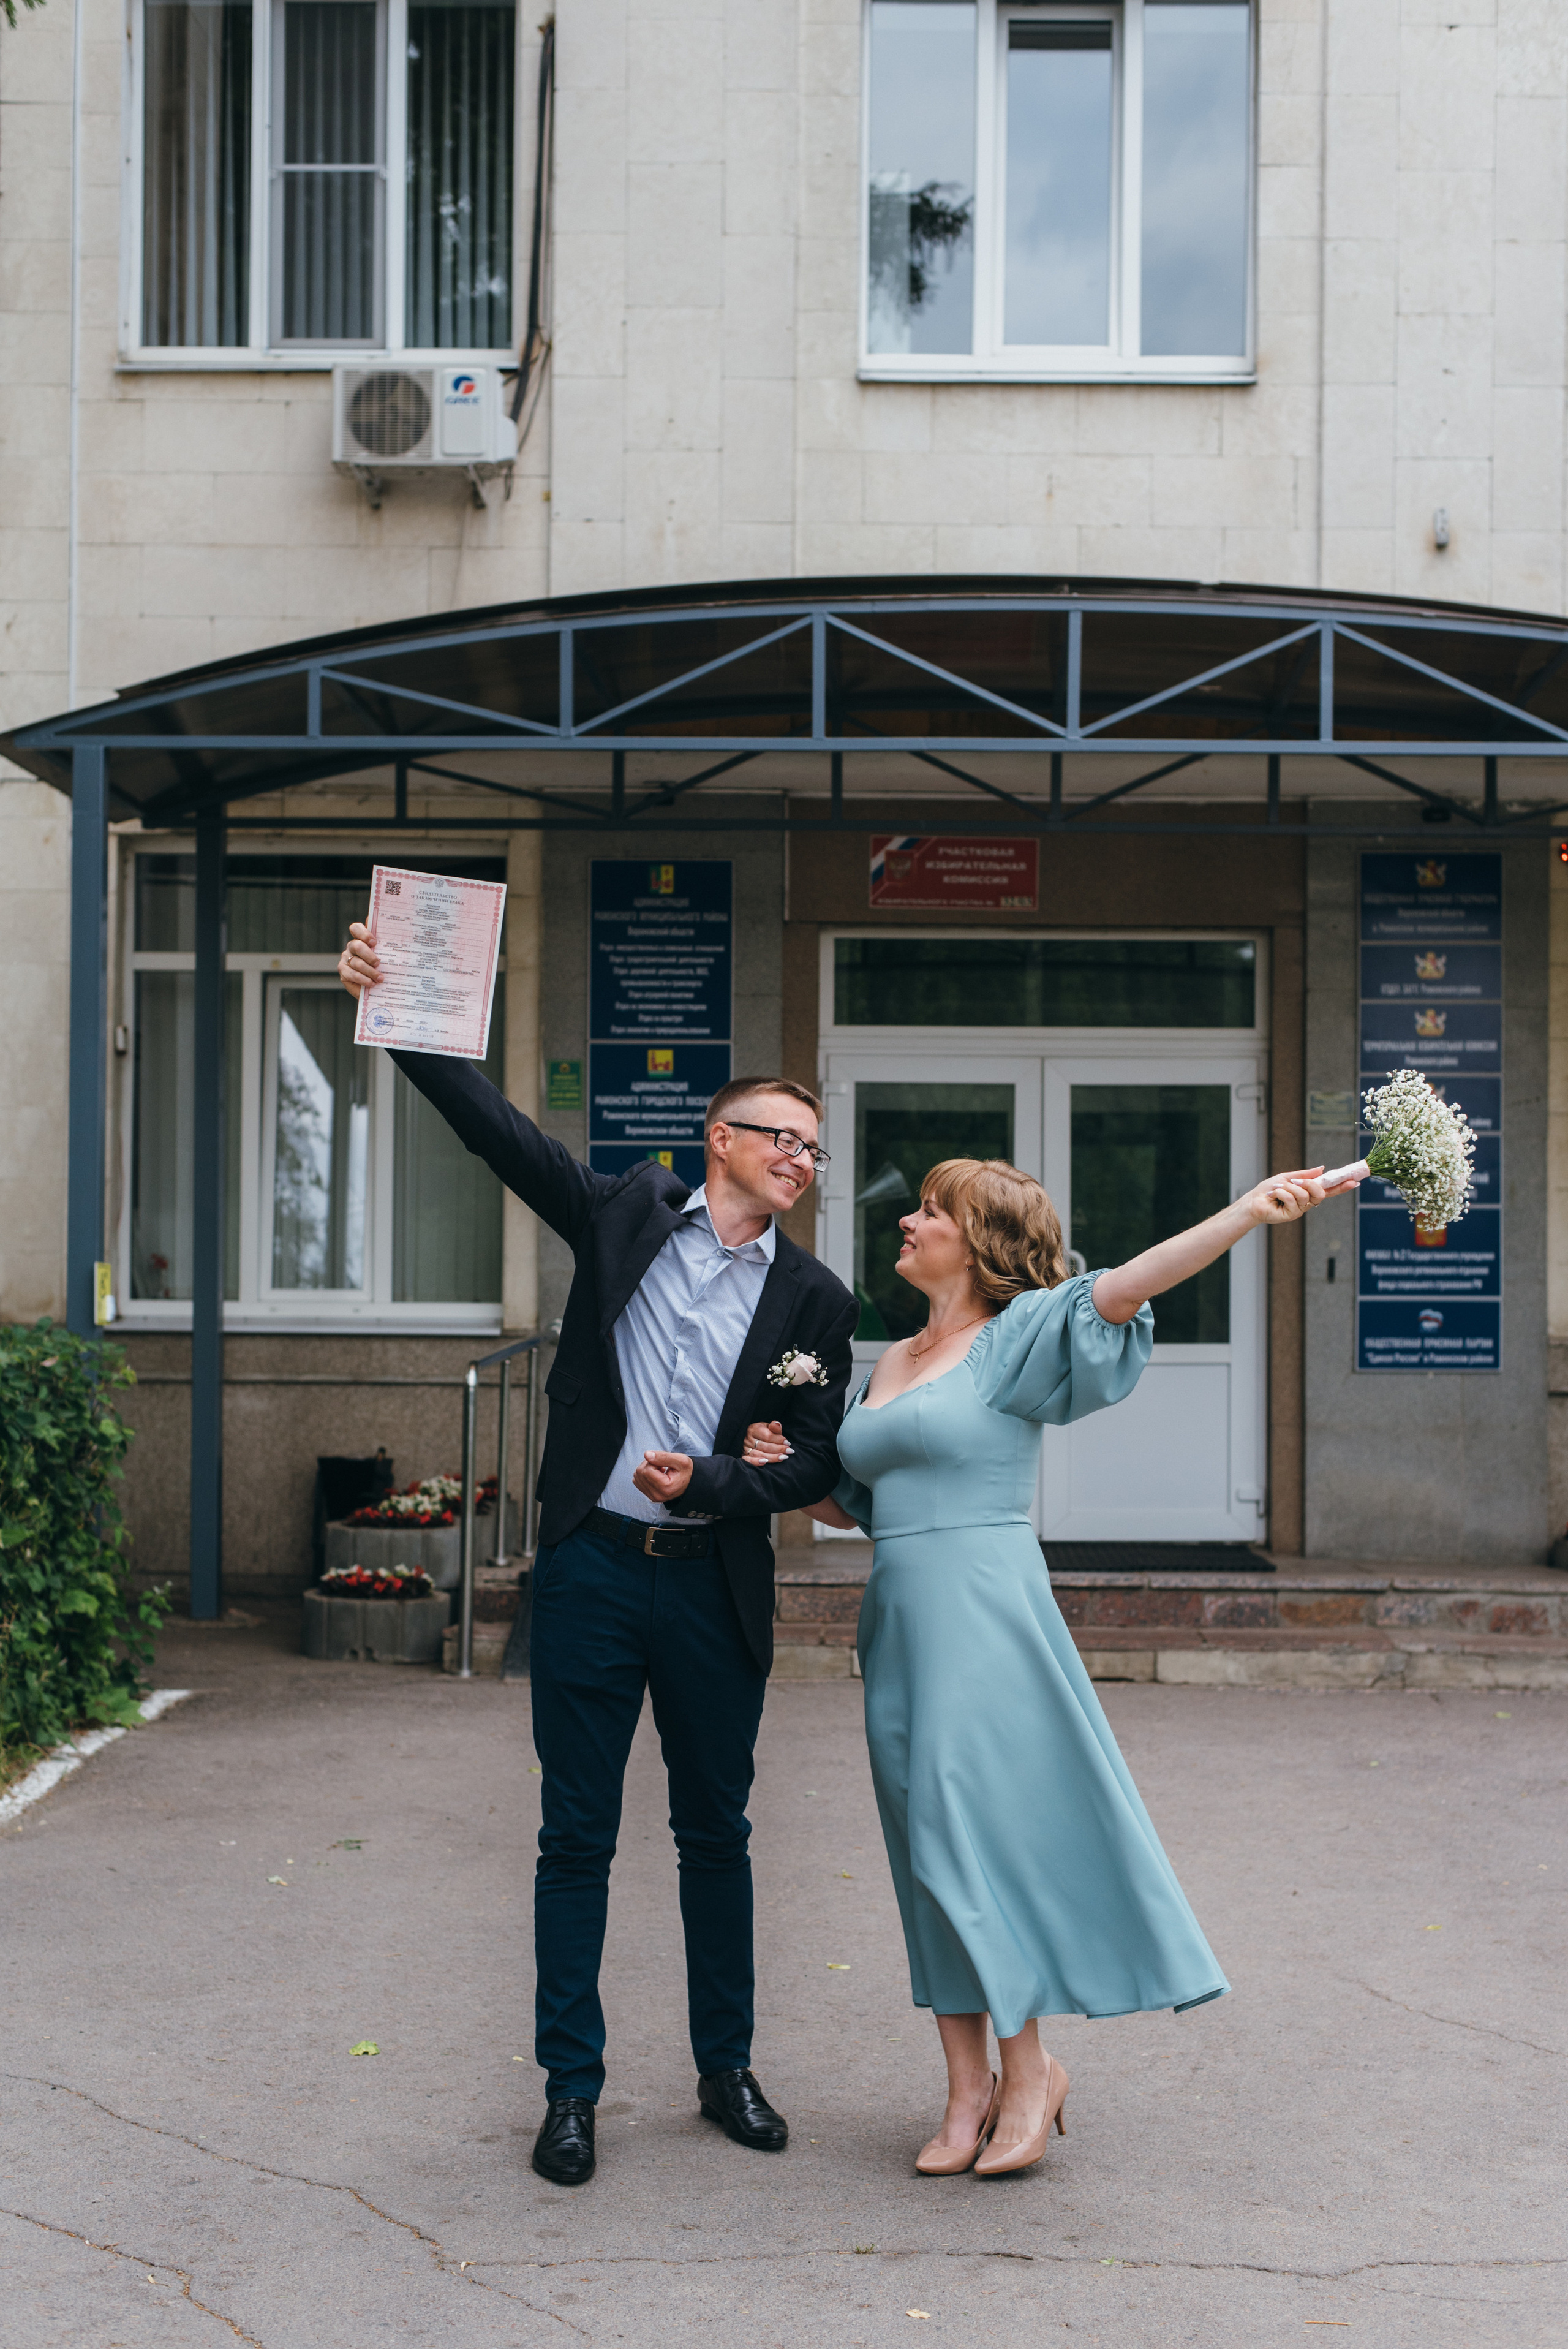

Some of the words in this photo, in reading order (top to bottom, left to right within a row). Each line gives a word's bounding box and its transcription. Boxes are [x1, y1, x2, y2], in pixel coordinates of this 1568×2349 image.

[938, 847, 1014, 857] УЧАСТКОВАЯ
[925, 860, 1027, 871] ИЗБИРАТЕЛЬНАЯ
[943, 875, 1009, 885] КОМИССИЯ
[419, 890, 457, 899] СВИДЕТЕЛЬСТВО
